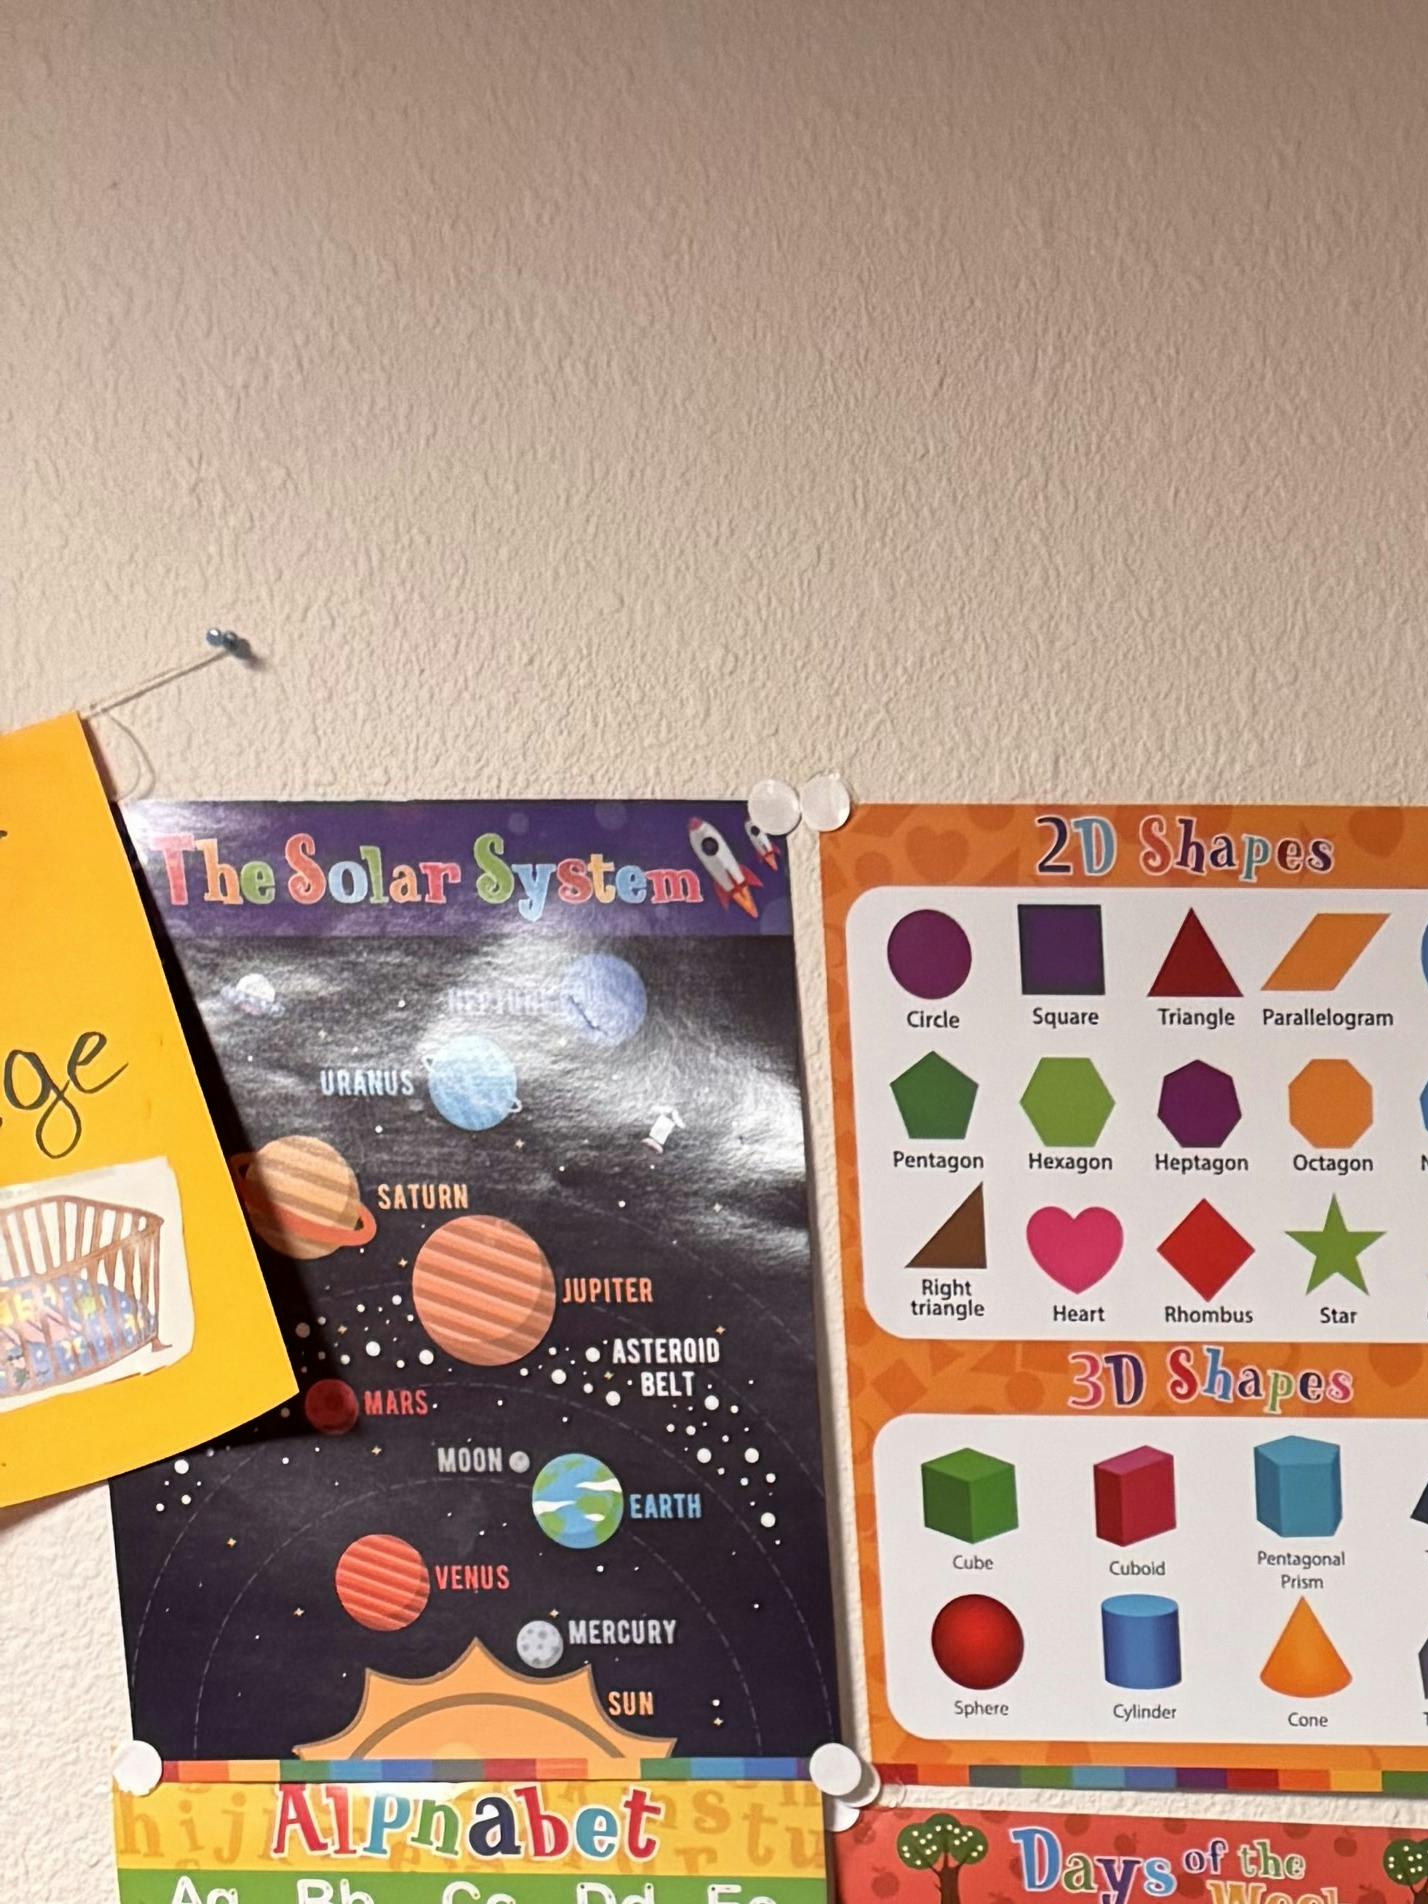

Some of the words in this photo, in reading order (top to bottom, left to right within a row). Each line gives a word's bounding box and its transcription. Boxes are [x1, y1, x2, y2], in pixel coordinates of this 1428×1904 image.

[1034, 815, 1115, 877] 2D
[1139, 816, 1334, 883] Shapes
[150, 834, 274, 907] The
[285, 832, 461, 905] Solar
[474, 832, 703, 921] System
[907, 1009, 959, 1030] Circle
[1032, 1007, 1099, 1029] Square
[1158, 1007, 1235, 1030] Triangle
[1262, 1009, 1394, 1031] Parallelogram
[0, 1031, 128, 1159] ge
[320, 1070, 415, 1097] URANUS
[893, 1151, 983, 1173] Pentagon
[1028, 1153, 1113, 1173] Hexagon
[1292, 1154, 1373, 1174] Octagon
[378, 1185, 468, 1210] SATURN
[563, 1278, 654, 1305] JUPITER
[921, 1279, 972, 1301] Right
[910, 1298, 985, 1321] triangle
[1165, 1305, 1253, 1324] Rhombus
[612, 1339, 720, 1365] ASTEROID
[641, 1372, 694, 1397] BELT
[1067, 1351, 1145, 1409] 3D
[1166, 1346, 1354, 1414] Shapes
[364, 1391, 428, 1417] MARS
[437, 1449, 503, 1473] MOON
[629, 1495, 702, 1519] EARTH
[1257, 1550, 1346, 1572] Pentagonal
[436, 1566, 510, 1590] VENUS
[1281, 1574, 1324, 1591] Prism
[568, 1621, 677, 1646] MERCURY
[609, 1692, 654, 1716] SUN
[1113, 1703, 1177, 1723] Cylinder
[1183, 1840, 1228, 1875] of
[1240, 1839, 1306, 1881] the
